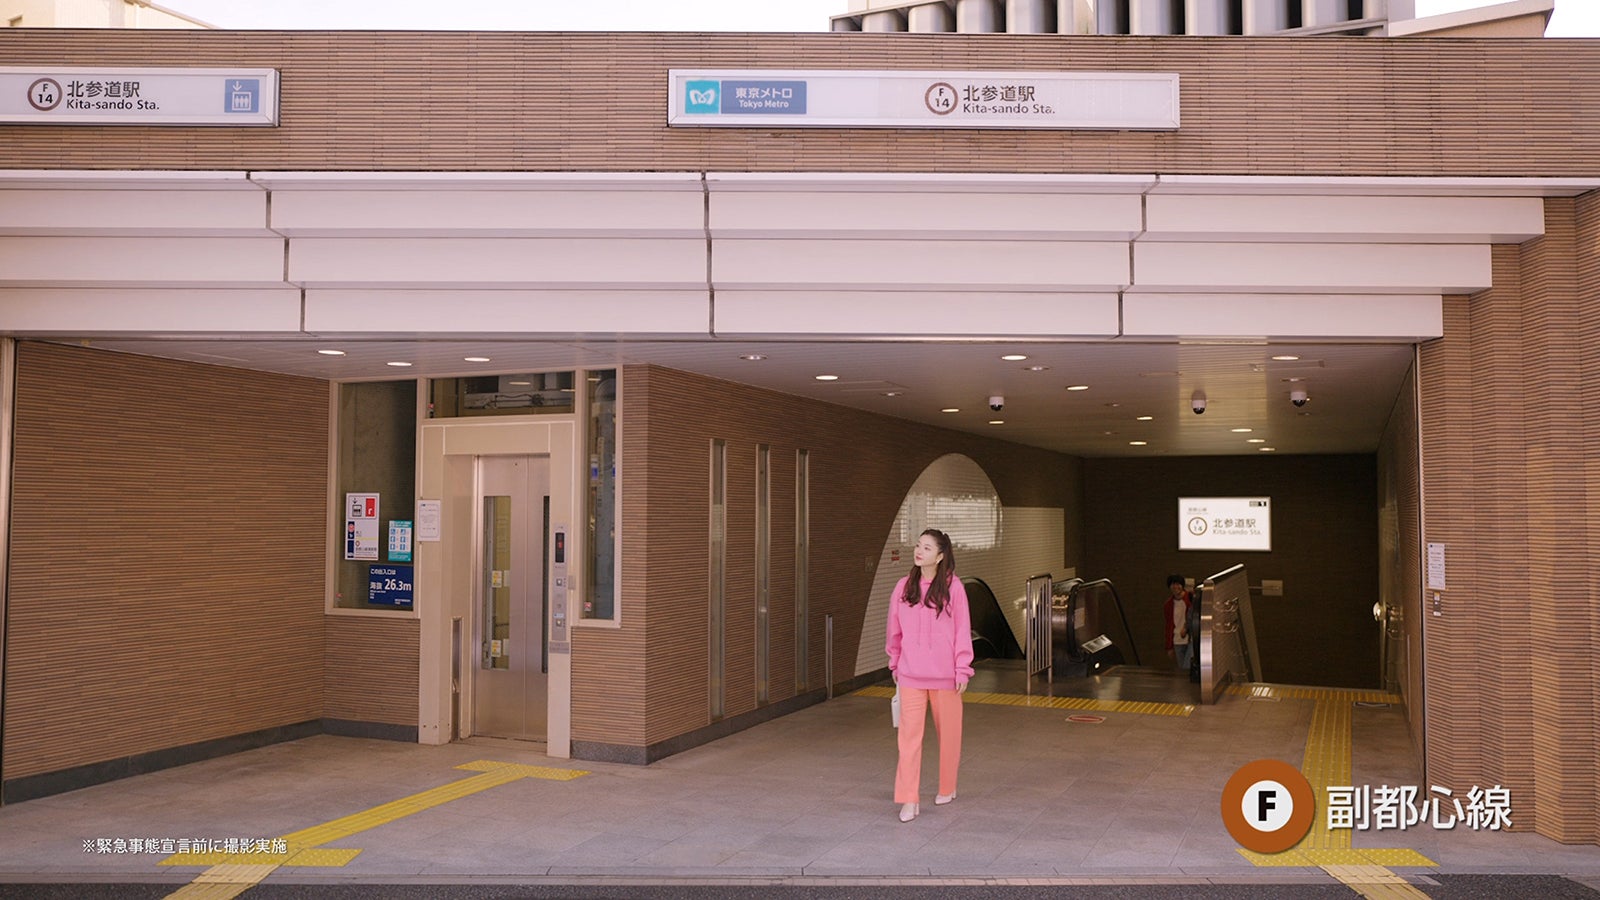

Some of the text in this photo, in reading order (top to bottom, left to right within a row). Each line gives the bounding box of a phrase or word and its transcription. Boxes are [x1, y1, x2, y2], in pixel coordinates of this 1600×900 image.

[42, 84, 49, 93] F
[67, 81, 140, 98] 北参道駅
[735, 87, 793, 99] 東京メトロ
[938, 88, 944, 97] F
[963, 84, 1036, 102] 北参道駅
[37, 93, 54, 104] 14
[935, 98, 950, 108] 14
[66, 99, 160, 110] Kita-sando Sta.
[739, 100, 790, 109] Tokyo Metro
[963, 103, 1056, 114] Kita-sando Sta.
[1212, 518, 1257, 528] 北参道駅
[384, 578, 412, 591] 26.3m
